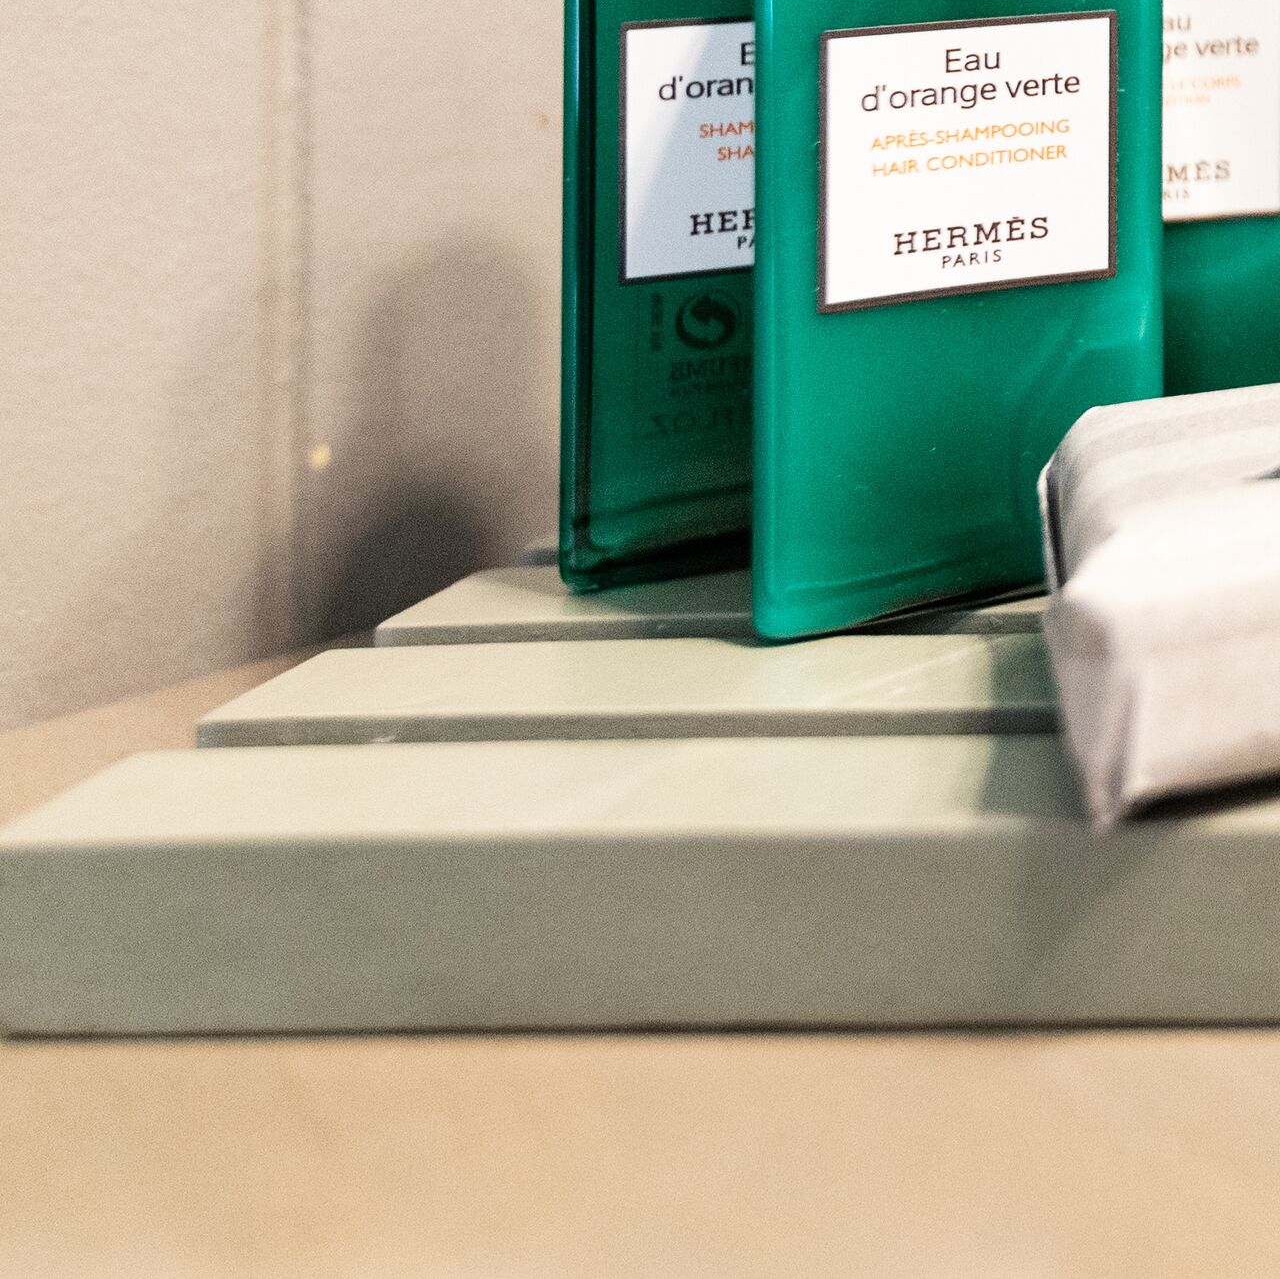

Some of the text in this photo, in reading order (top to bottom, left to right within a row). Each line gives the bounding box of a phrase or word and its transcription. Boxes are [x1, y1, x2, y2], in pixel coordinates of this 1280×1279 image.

[945, 48, 1001, 73] Eau
[1195, 35, 1260, 56] verte
[861, 73, 1081, 113] d'orange verte
[870, 119, 1071, 151] APRÈS-SHAMPOOING
[872, 144, 1067, 177] HAIR CONDITIONER
[893, 216, 1049, 256] HERMÈS
[942, 249, 1002, 269] PARIS
